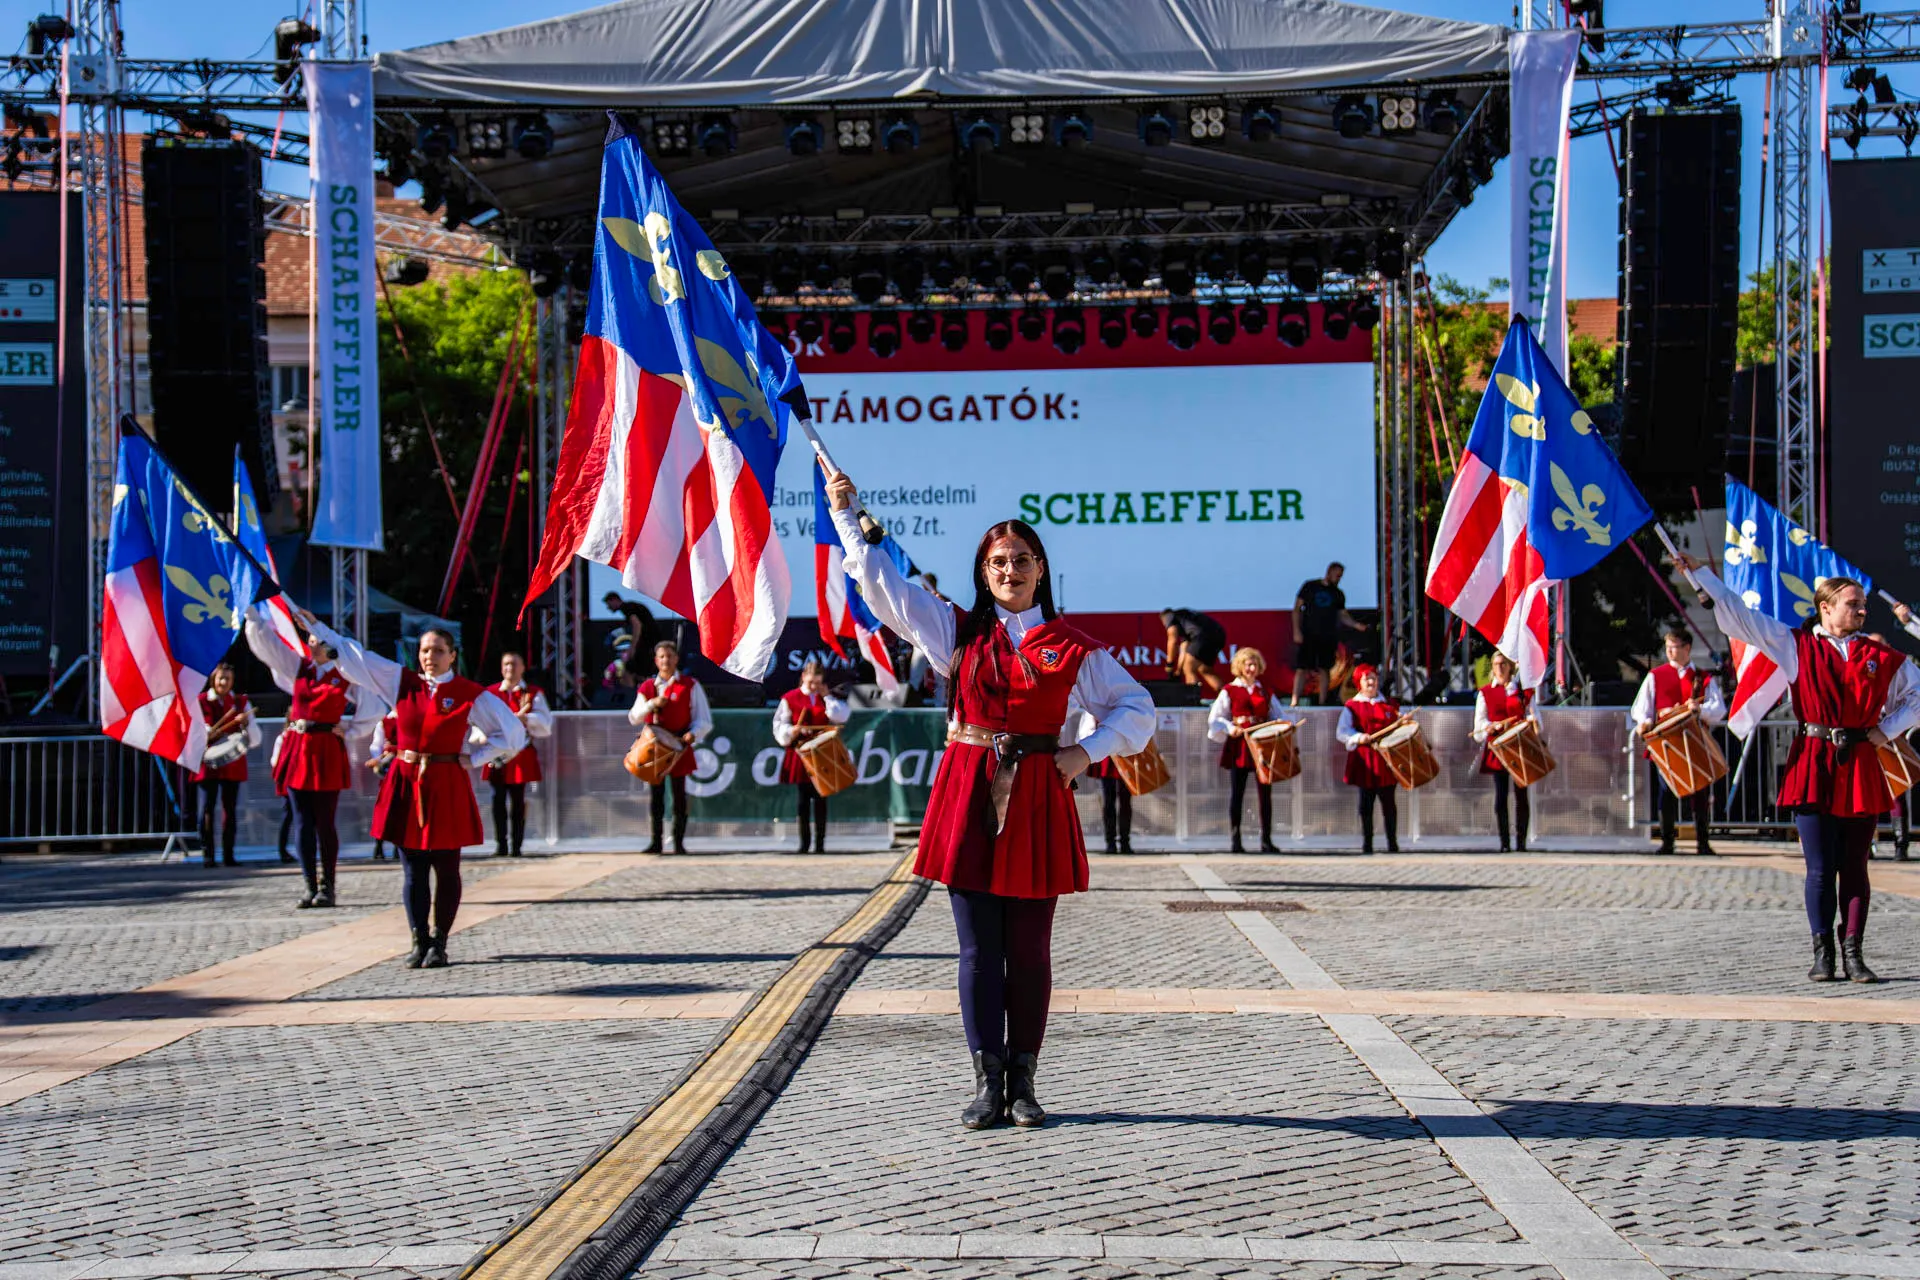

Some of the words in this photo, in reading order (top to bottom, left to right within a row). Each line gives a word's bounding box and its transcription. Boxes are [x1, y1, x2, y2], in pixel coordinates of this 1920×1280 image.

[330, 185, 361, 432] SCHAEFFLER
[1869, 322, 1920, 349] SC
[0, 351, 48, 376] ER
[808, 386, 1080, 424] TÁMOGATÓK:
[859, 484, 976, 505] ereskedelmi
[1019, 489, 1304, 525] SCHAEFFLER
[912, 515, 946, 537] Zrt.
